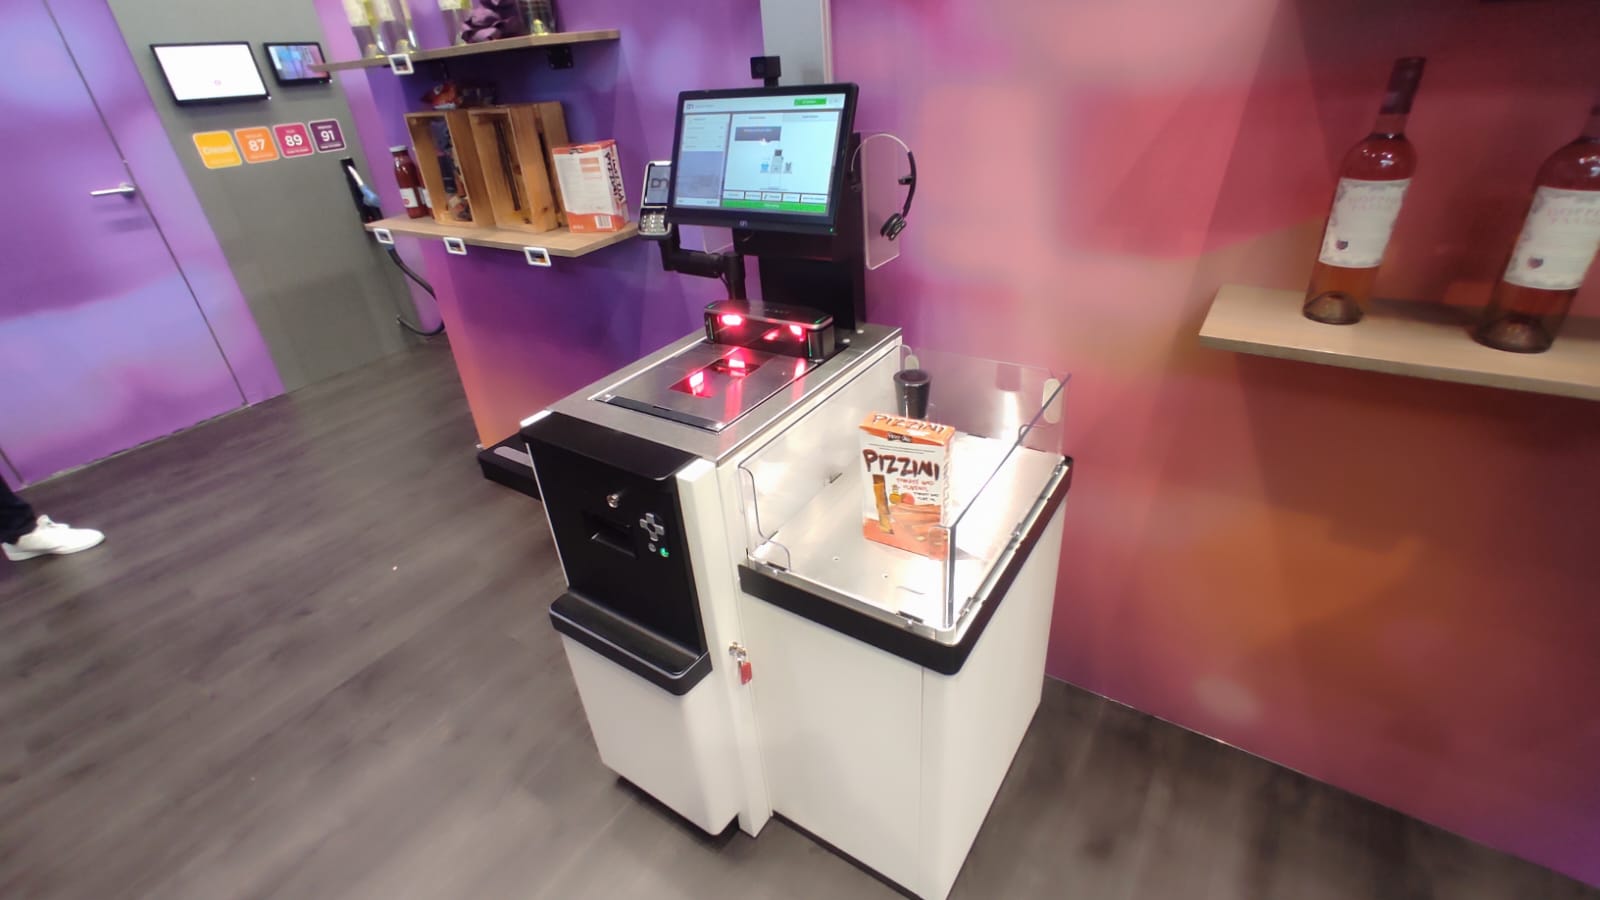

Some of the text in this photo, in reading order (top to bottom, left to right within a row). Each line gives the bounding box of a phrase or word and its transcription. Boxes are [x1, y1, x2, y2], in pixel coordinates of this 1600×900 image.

[285, 134, 303, 147] 89
[321, 130, 336, 142] 91
[248, 139, 265, 151] 87
[872, 414, 945, 434] PIZZINI
[862, 448, 940, 481] PIZZINI
